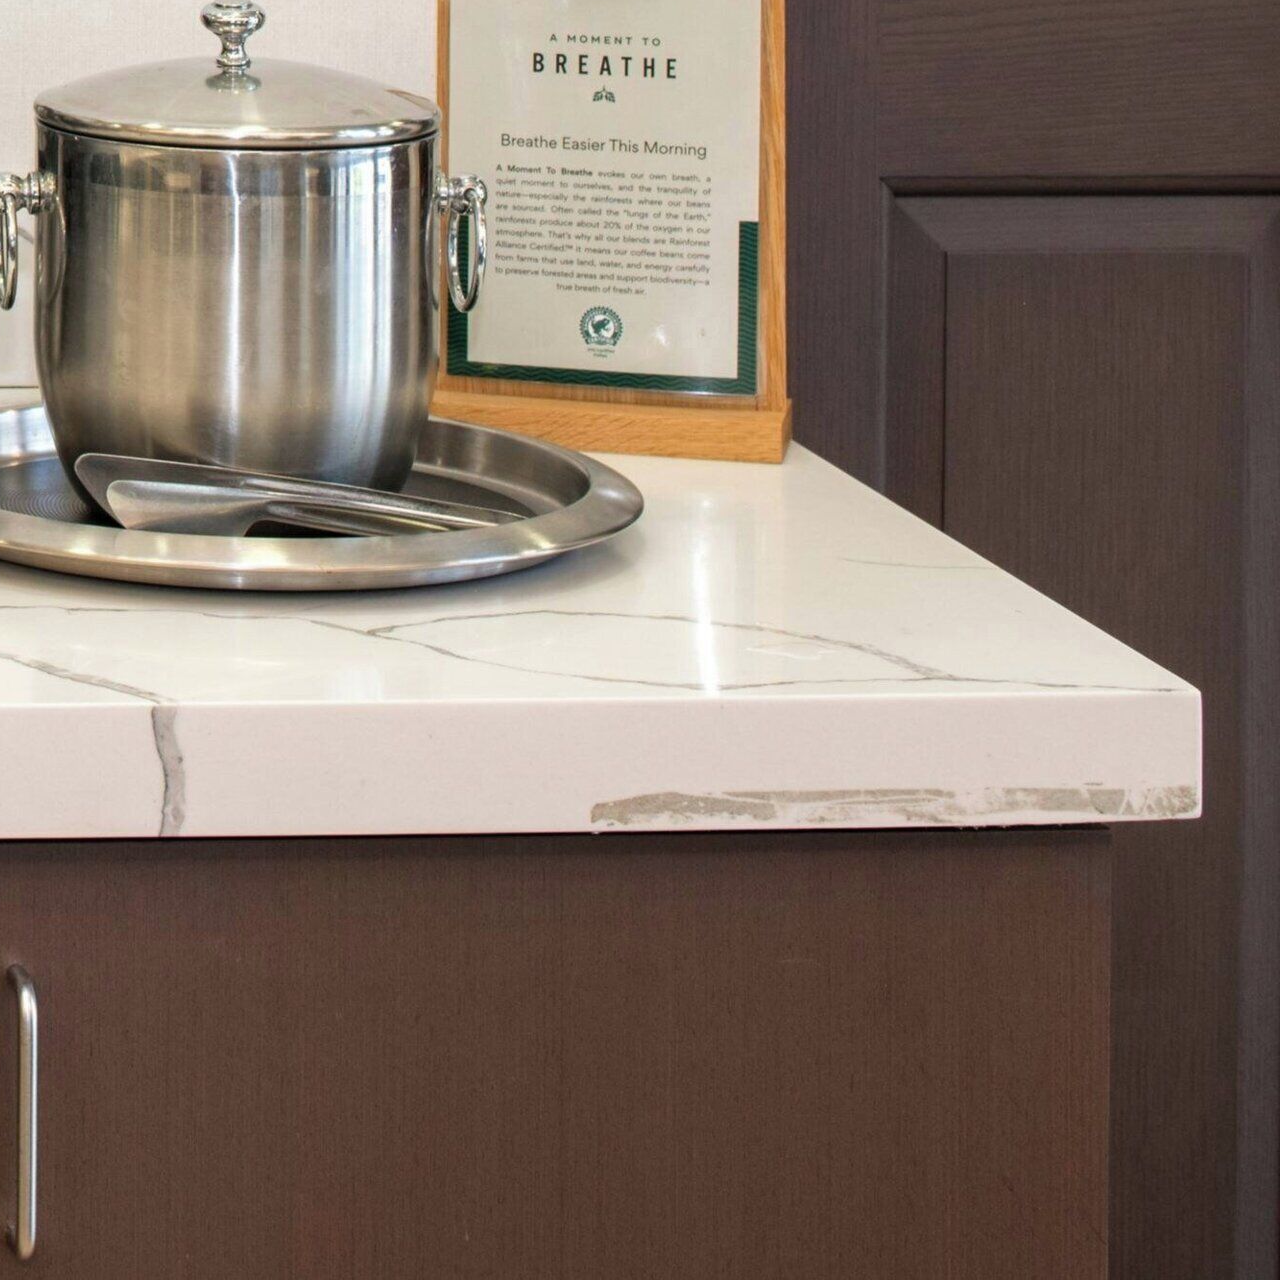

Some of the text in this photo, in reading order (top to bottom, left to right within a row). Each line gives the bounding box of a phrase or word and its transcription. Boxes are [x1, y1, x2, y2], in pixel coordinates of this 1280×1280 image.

[549, 33, 661, 47] A MOMENT TO
[532, 52, 677, 79] BREATHE
[501, 133, 707, 160] Breathe Easier This Morning
[508, 165, 541, 174] Moment
[546, 166, 556, 174] To
[561, 167, 593, 176] Breathe
[598, 170, 625, 178] evokes
[657, 186, 697, 196] tranquility
[573, 193, 586, 201] the
[638, 198, 662, 206] where
[686, 200, 710, 208] beans
[550, 205, 573, 214] Often
[577, 207, 602, 215] called
[539, 218, 573, 227] produce
[576, 220, 600, 228] about
[652, 225, 683, 234] oxygen
[575, 233, 591, 241] why
[623, 235, 650, 244] blends
[670, 237, 710, 246] Rainforest
[495, 241, 526, 249] Alliance
[630, 249, 656, 257] coffee
[495, 253, 513, 261] from
[516, 254, 539, 263] farms
[541, 256, 557, 264] that
[644, 263, 673, 272] energy
[675, 264, 710, 273] carefully
[505, 267, 539, 276] preserve
[541, 269, 574, 278] forested
[617, 274, 648, 283] support
[574, 284, 600, 293] breath
[612, 286, 632, 294] fresh
